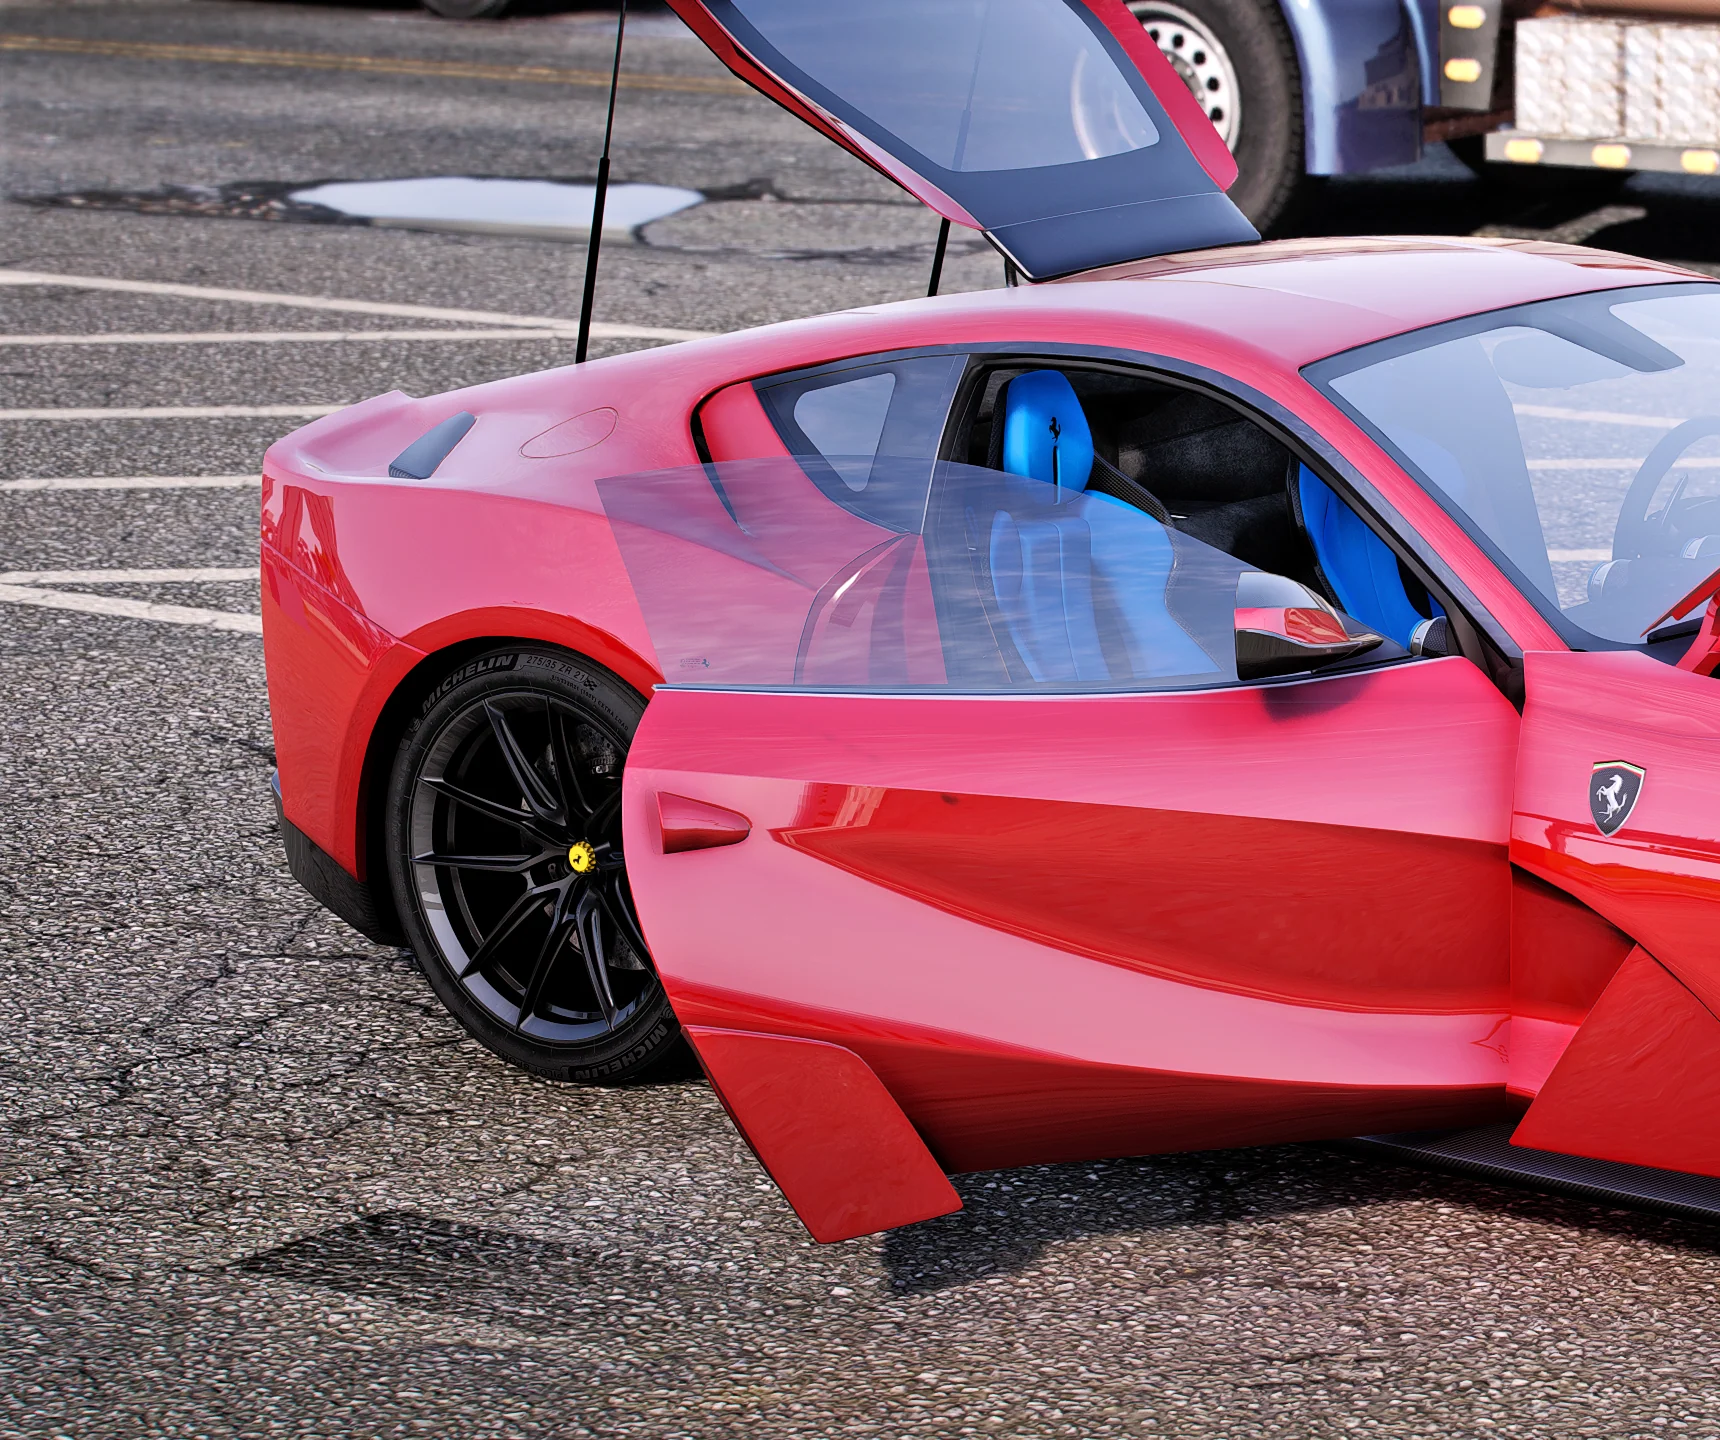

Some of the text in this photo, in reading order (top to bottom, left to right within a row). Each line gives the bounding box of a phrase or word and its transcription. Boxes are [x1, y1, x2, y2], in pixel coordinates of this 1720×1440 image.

[421, 655, 514, 713] MICHELIN
[526, 656, 585, 680] 275/35 ZR 21
[575, 1023, 669, 1080] MICHELIN
